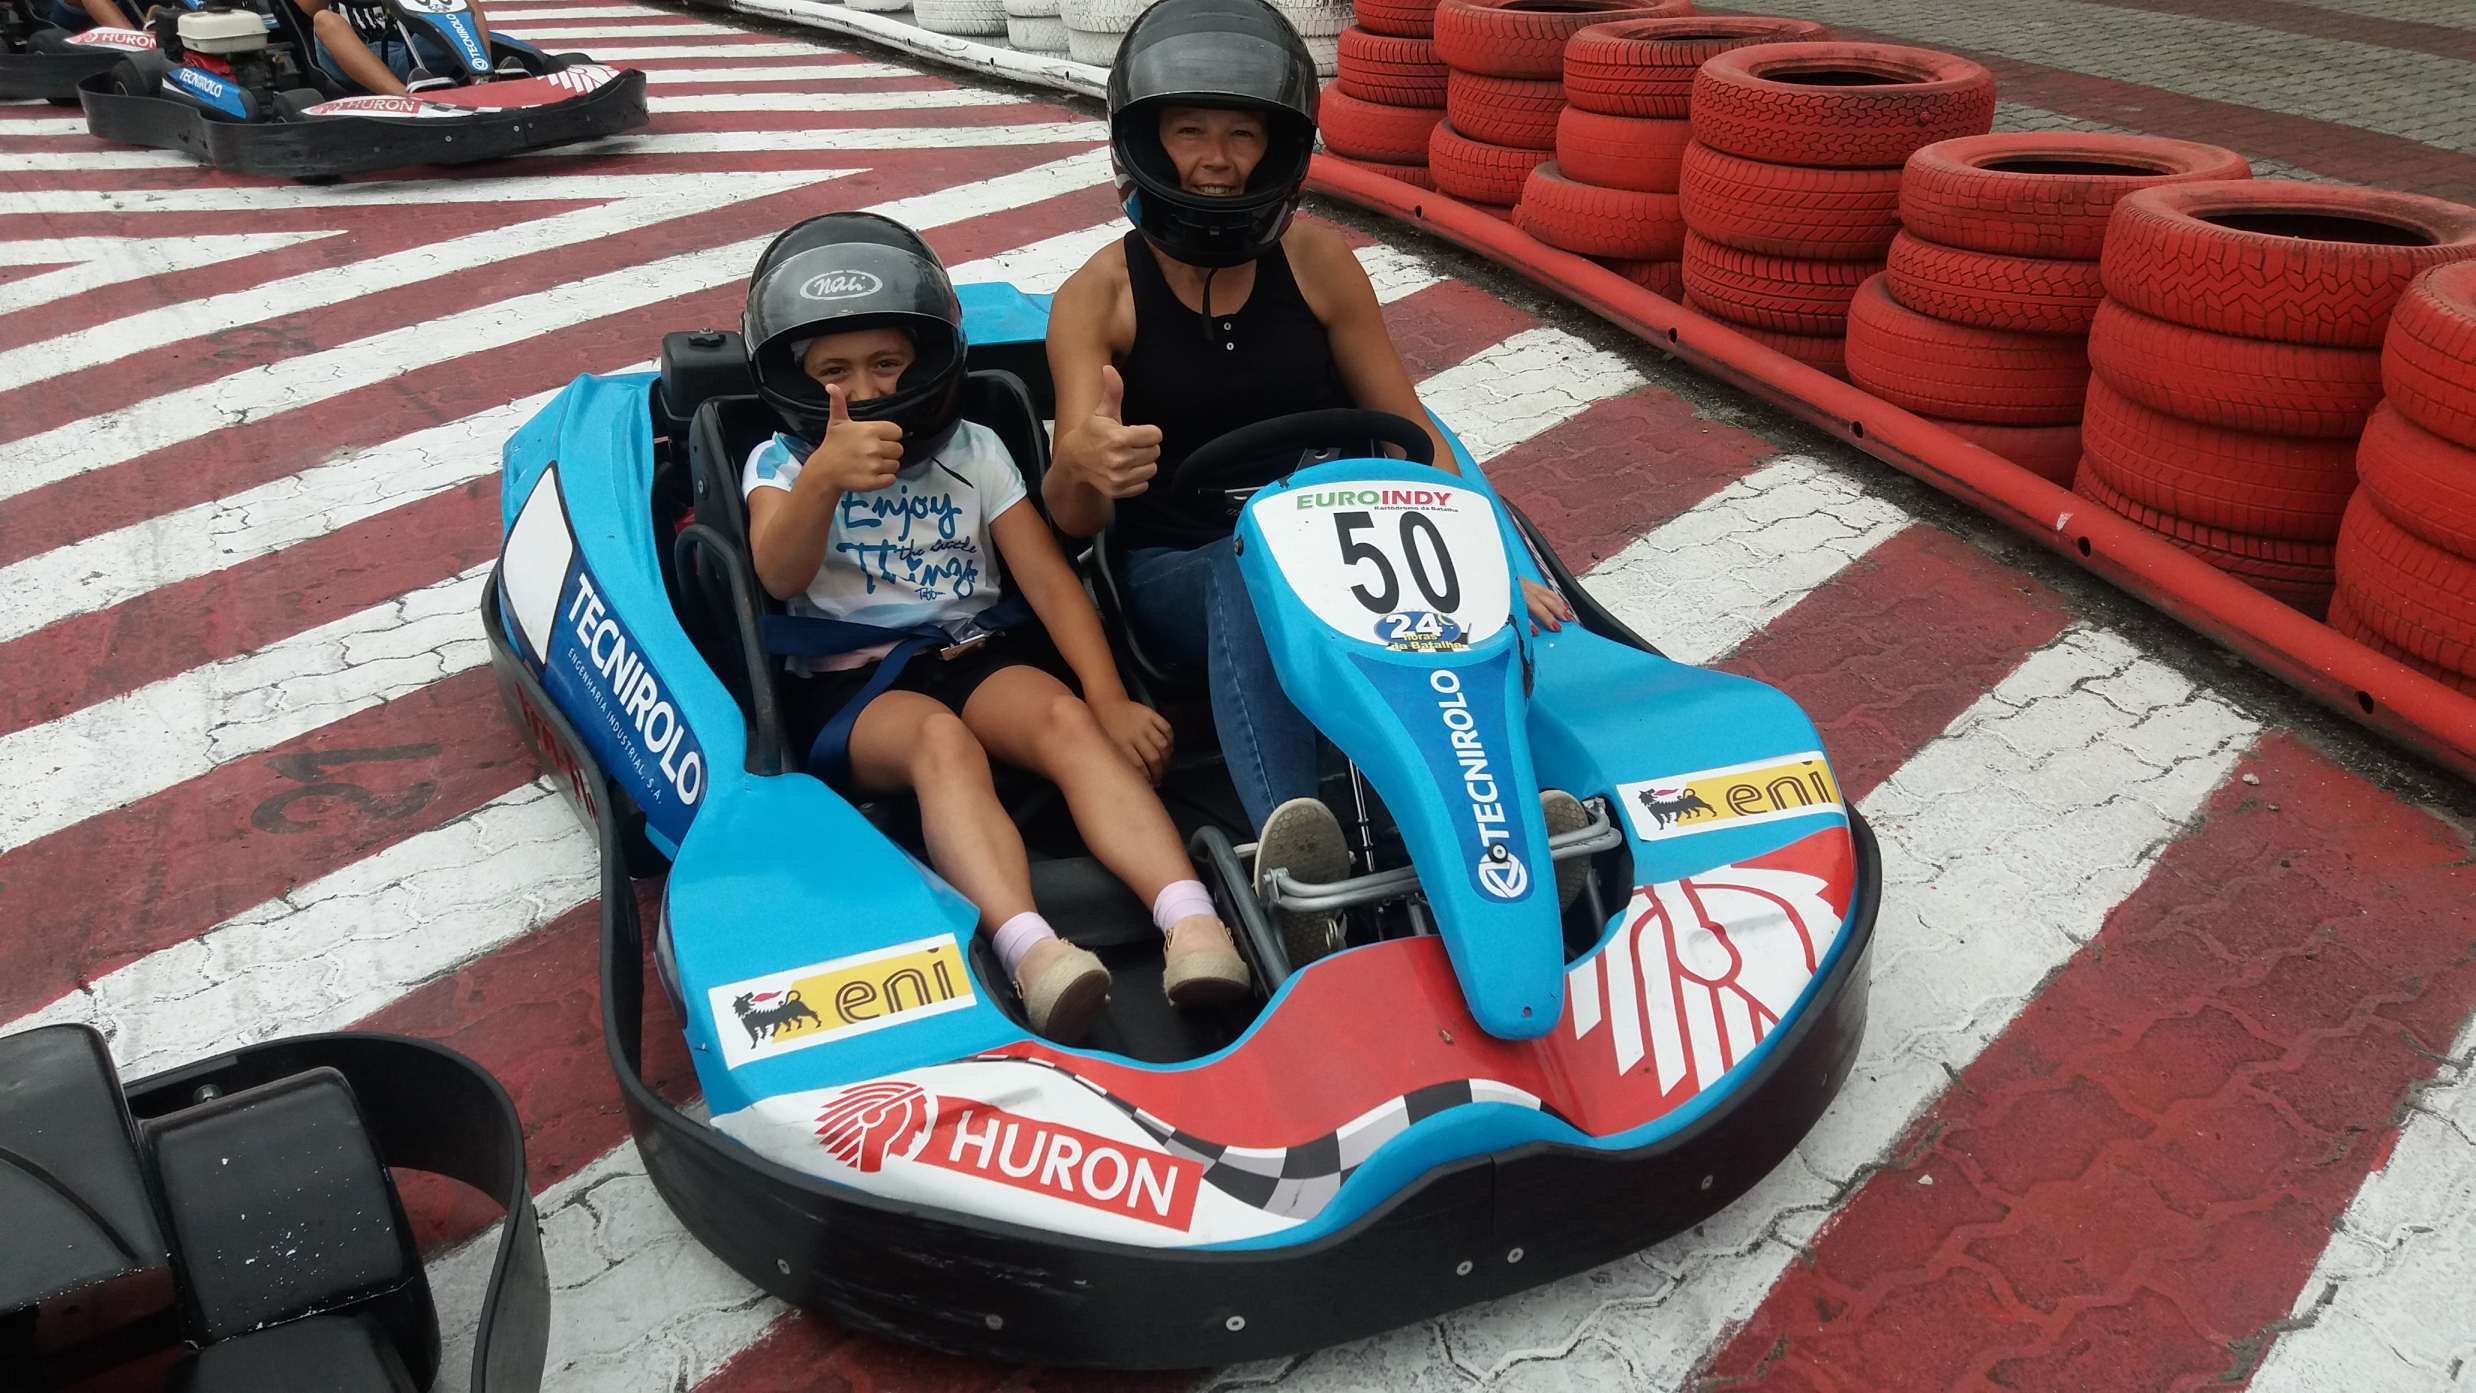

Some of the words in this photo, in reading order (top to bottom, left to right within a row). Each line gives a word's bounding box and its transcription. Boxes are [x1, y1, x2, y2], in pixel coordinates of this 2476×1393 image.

[101, 32, 157, 48] HURON
[446, 14, 480, 60] TECNIROLO
[349, 99, 415, 113] HURON
[841, 485, 963, 542] Enjoy
[1296, 490, 1453, 510] EUROINDY
[1333, 510, 1461, 615] 50
[1386, 613, 1443, 639] 24
[1410, 640, 1464, 650] Batalha
[567, 647, 607, 713] ENGENHARIA
[567, 572, 702, 806] TECNIROLO
[1430, 668, 1511, 848] TECNIROLO
[1725, 760, 1834, 817] eni
[835, 946, 957, 1026] eni
[948, 1109, 1180, 1218] HURON
